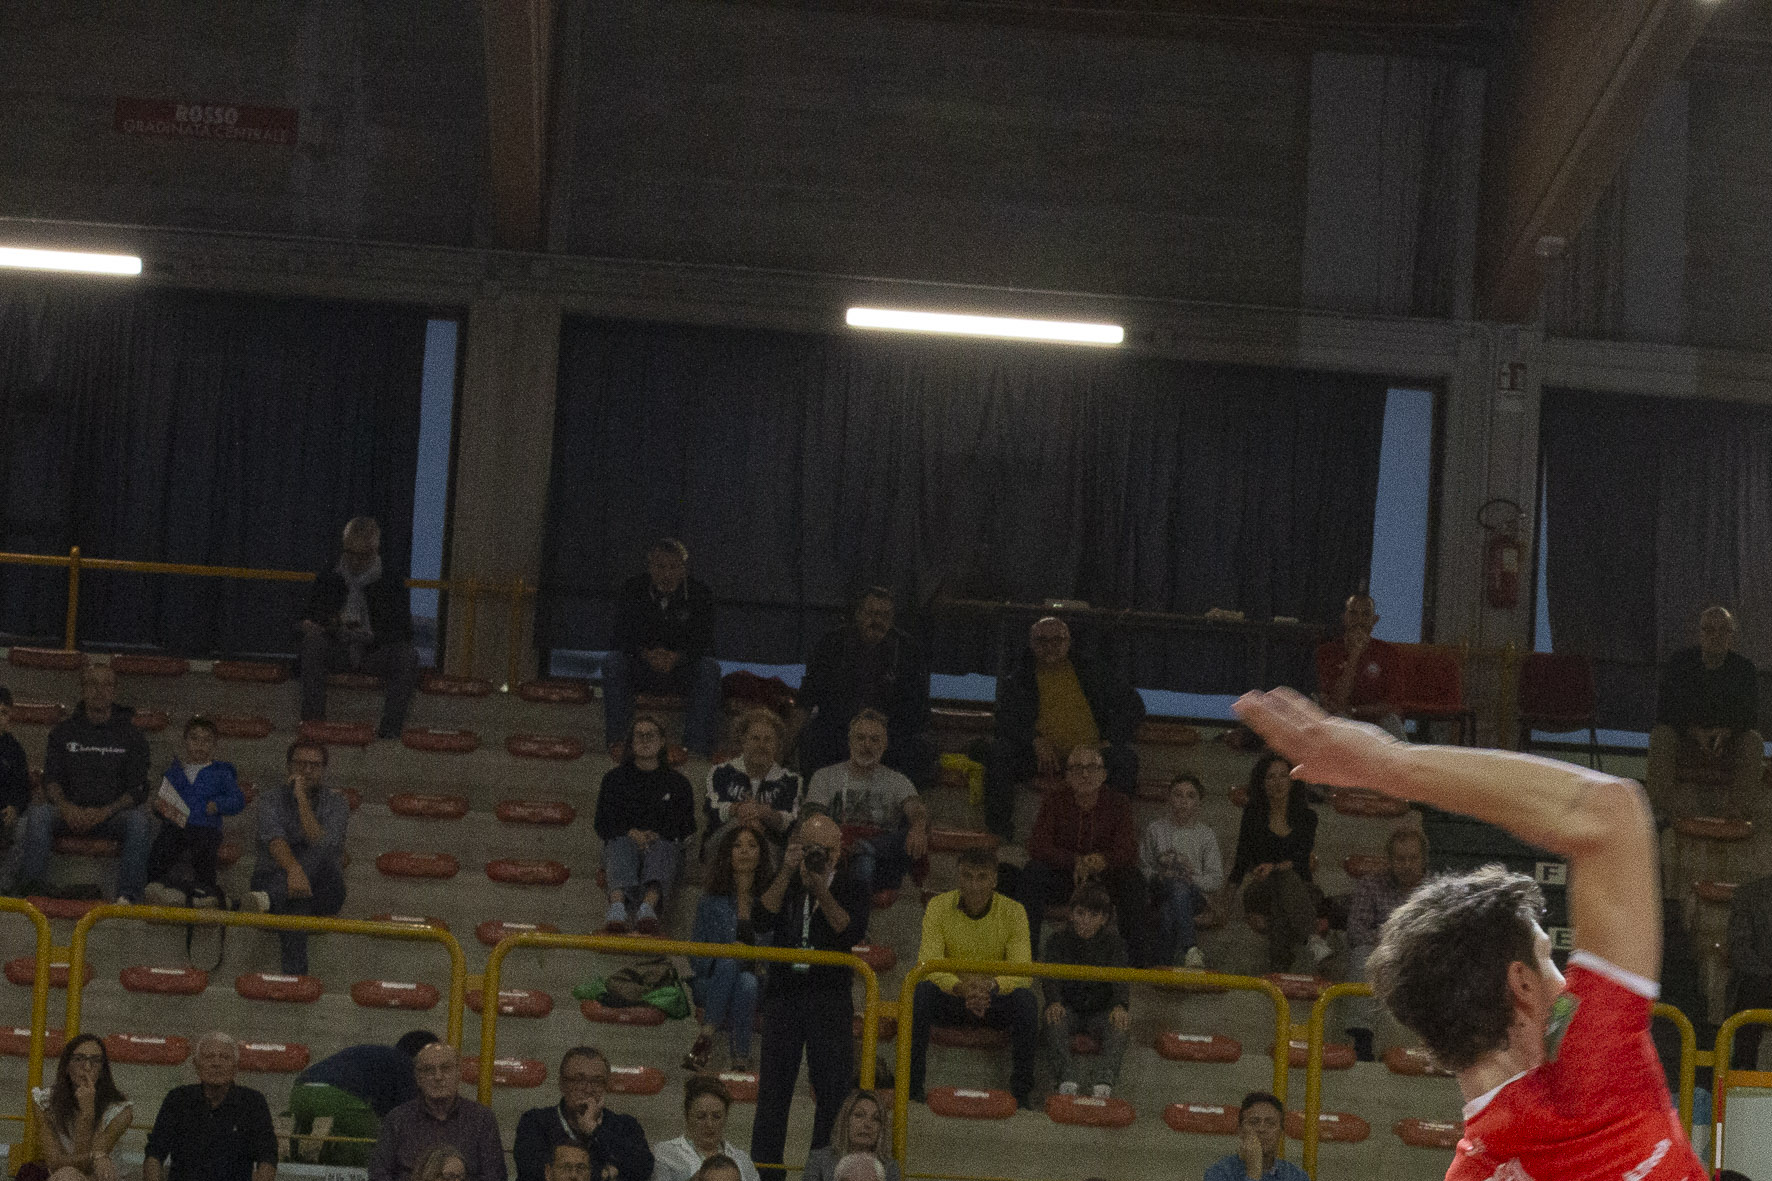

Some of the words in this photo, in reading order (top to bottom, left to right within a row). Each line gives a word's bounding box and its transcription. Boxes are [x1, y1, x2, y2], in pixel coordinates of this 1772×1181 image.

[175, 104, 239, 125] ROSSO
[67, 741, 126, 756] Champion
[1543, 865, 1559, 881] F
[1556, 929, 1573, 947] E
